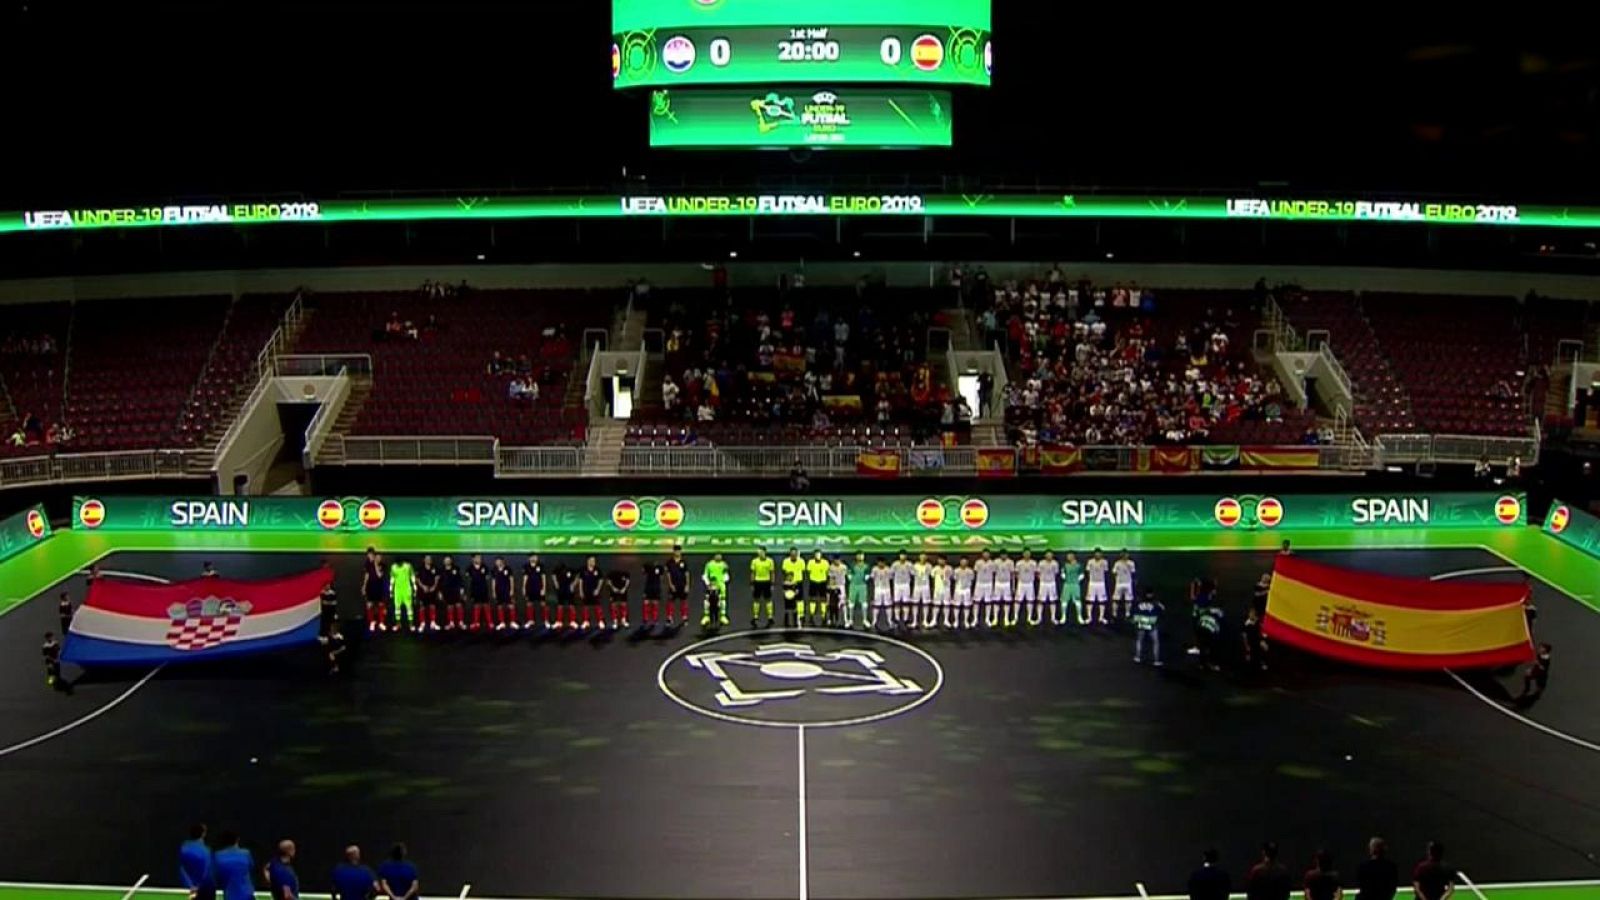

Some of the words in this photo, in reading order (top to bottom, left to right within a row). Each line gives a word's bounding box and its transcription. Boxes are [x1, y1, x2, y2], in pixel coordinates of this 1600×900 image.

[790, 29, 806, 39] 1st
[807, 27, 829, 39] Half
[709, 38, 731, 66] 0
[778, 41, 840, 61] 20:00
[880, 38, 902, 65] 0
[25, 210, 74, 227] UEFA
[74, 208, 162, 226] UNDER-19
[162, 205, 234, 224] FUTSAL
[234, 204, 281, 221] EURO
[621, 197, 667, 214] UEFA
[668, 197, 757, 214] UNDER-19
[757, 195, 830, 214] FUTSAL
[831, 197, 880, 214] EURO
[1226, 199, 1270, 217] UEFA
[1270, 200, 1355, 219] UNDER-19
[1355, 201, 1425, 220] FUTSAL
[1425, 203, 1475, 220] EURO
[171, 501, 250, 526] SPAIN
[456, 501, 539, 526] SPAIN
[758, 501, 842, 526] SPAIN
[1061, 500, 1145, 525] SPAIN
[1352, 498, 1430, 523] SPAIN
